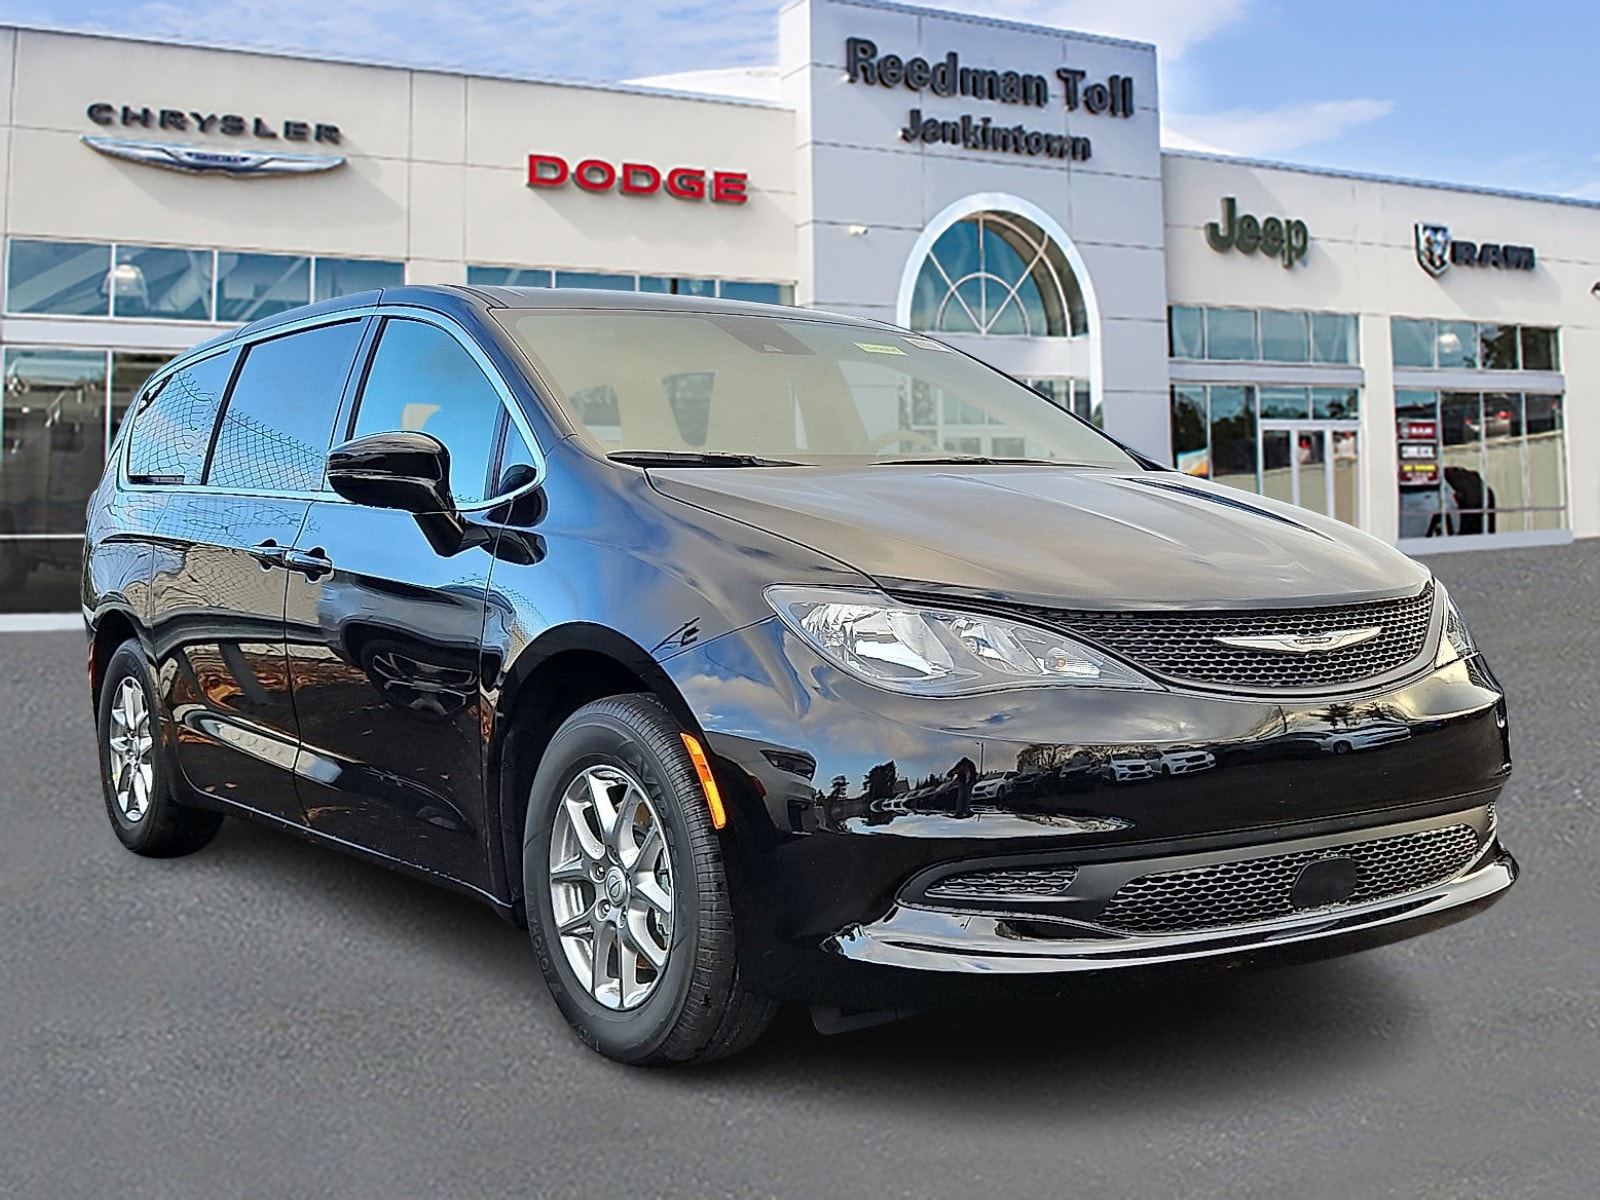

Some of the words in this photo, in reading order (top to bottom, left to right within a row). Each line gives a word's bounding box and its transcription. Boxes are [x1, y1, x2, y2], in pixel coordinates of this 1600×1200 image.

[846, 38, 1048, 107] Reedman
[1058, 67, 1133, 118] Toll
[87, 102, 342, 144] CHRYSLER
[901, 108, 1091, 161] Jenkintown
[527, 154, 748, 204] DODGE
[1205, 197, 1308, 268] Jeep
[1451, 241, 1535, 270] RAM
